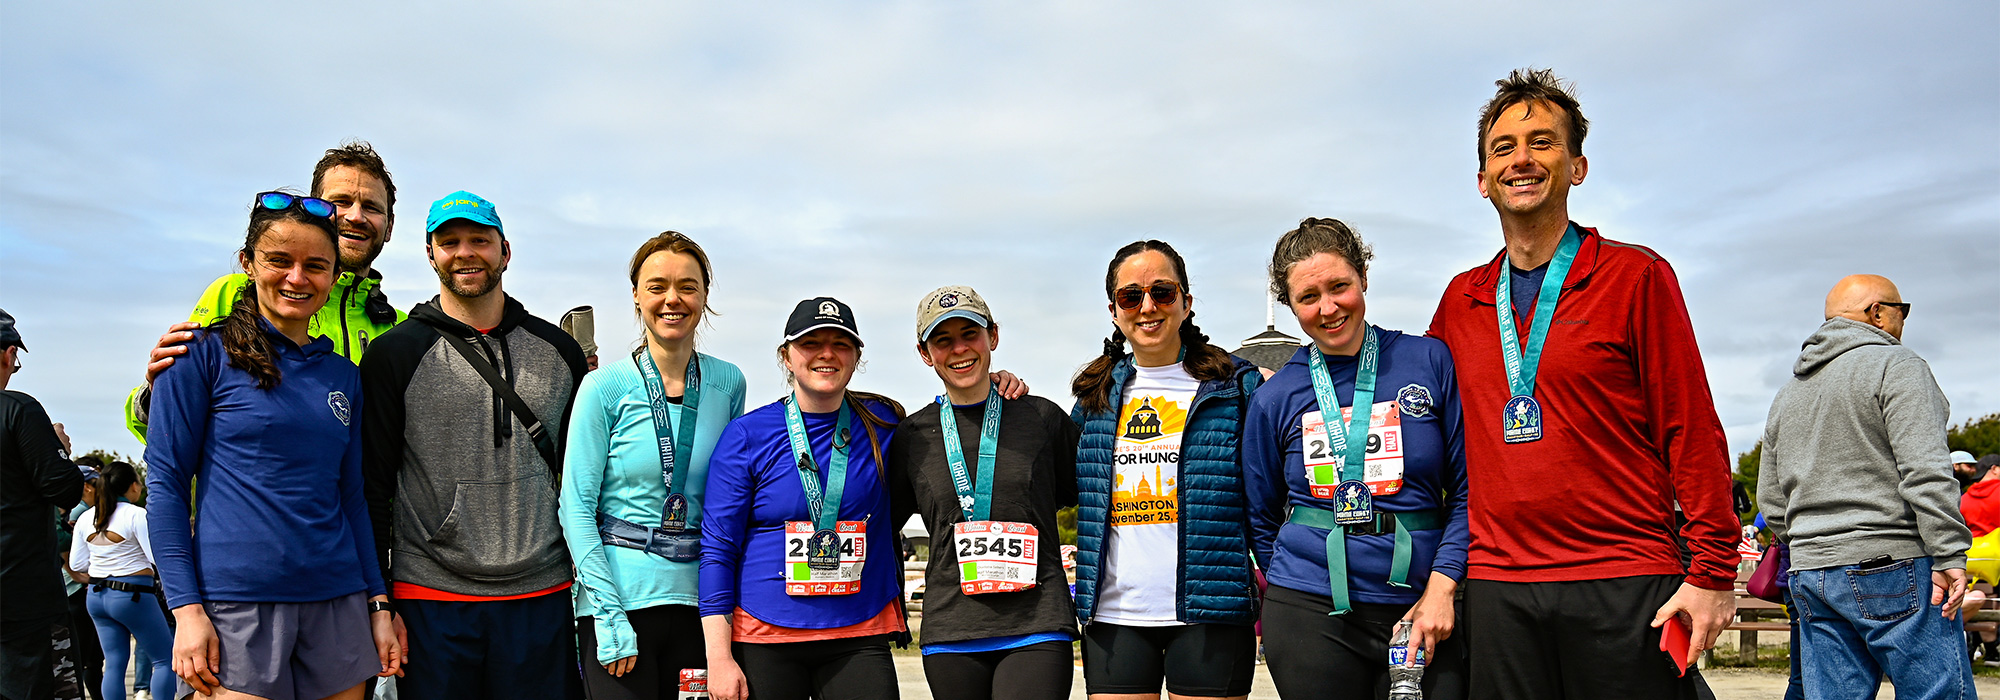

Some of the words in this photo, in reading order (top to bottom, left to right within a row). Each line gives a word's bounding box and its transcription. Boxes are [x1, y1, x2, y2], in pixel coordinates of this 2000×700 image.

[1499, 301, 1511, 325] HALF
[1327, 419, 1347, 453] MAINE
[1385, 432, 1398, 451] HALF
[660, 436, 675, 469] MAINE
[1309, 433, 1381, 460] 29
[1112, 453, 1137, 466] FOR
[1139, 452, 1179, 465] HUNG
[952, 460, 971, 493] MAINE
[1111, 499, 1178, 513] ASHINGTON,
[839, 522, 858, 532] Coast
[1111, 512, 1155, 524] ovember
[963, 523, 987, 532] Maine
[1007, 523, 1027, 533] Coast
[789, 537, 854, 557] 24
[855, 538, 863, 556] HALF
[959, 537, 1022, 558] 2545
[1024, 540, 1034, 558] HALF
[689, 682, 708, 691] Mai
